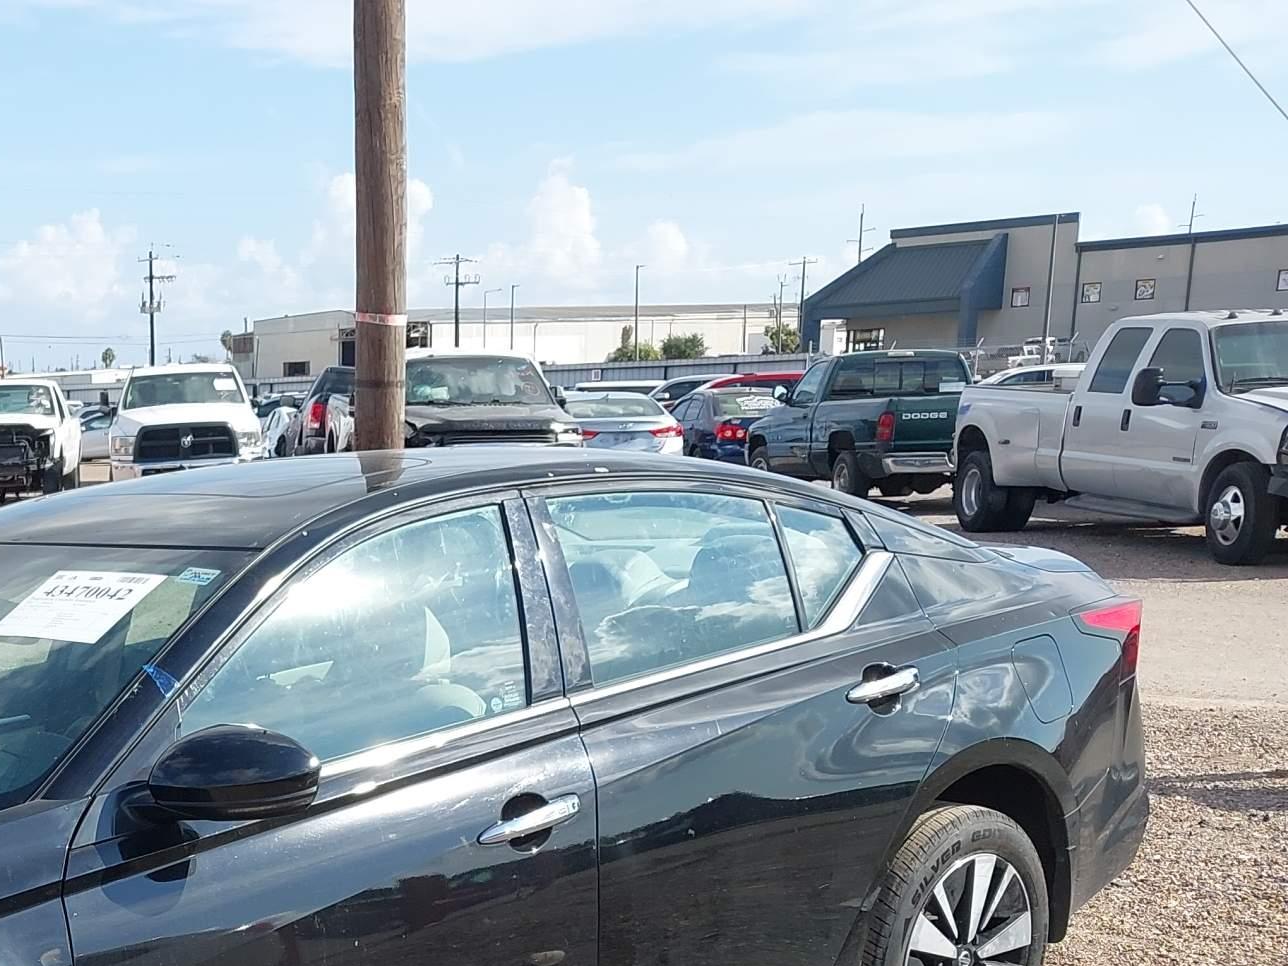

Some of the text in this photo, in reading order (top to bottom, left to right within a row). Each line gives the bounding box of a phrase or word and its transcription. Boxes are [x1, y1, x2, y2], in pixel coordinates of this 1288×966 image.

[902, 411, 948, 420] DODGE
[44, 584, 134, 601] 43470042
[911, 840, 962, 908] SILVER
